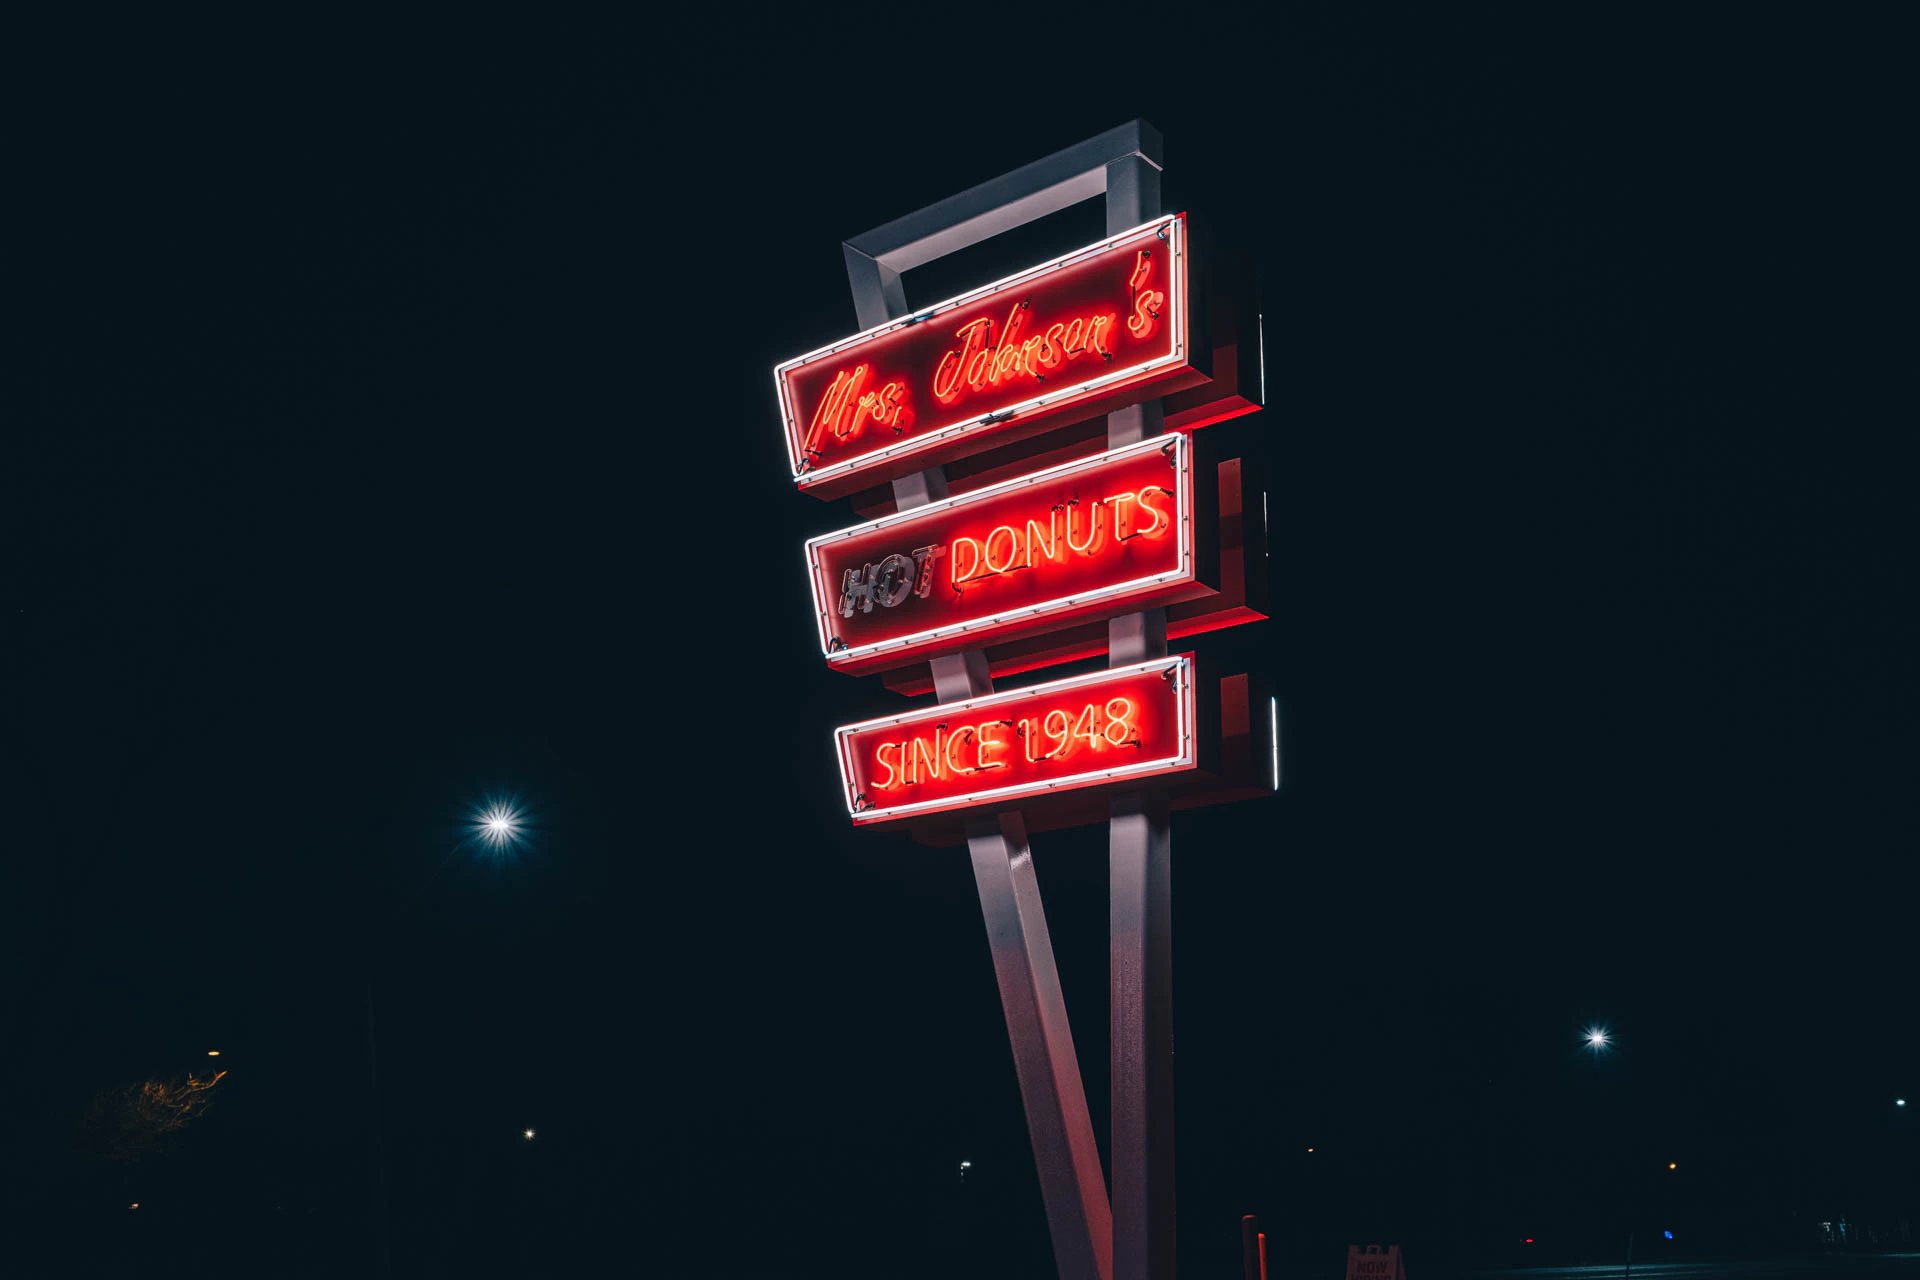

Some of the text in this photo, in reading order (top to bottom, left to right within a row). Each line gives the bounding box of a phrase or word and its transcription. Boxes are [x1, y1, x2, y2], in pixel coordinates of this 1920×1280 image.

[934, 251, 1163, 400] Johnson's
[838, 486, 1169, 618] HOT DONUTS
[871, 697, 1138, 790] SINCE 1948
[1357, 1261, 1388, 1274] NOW
